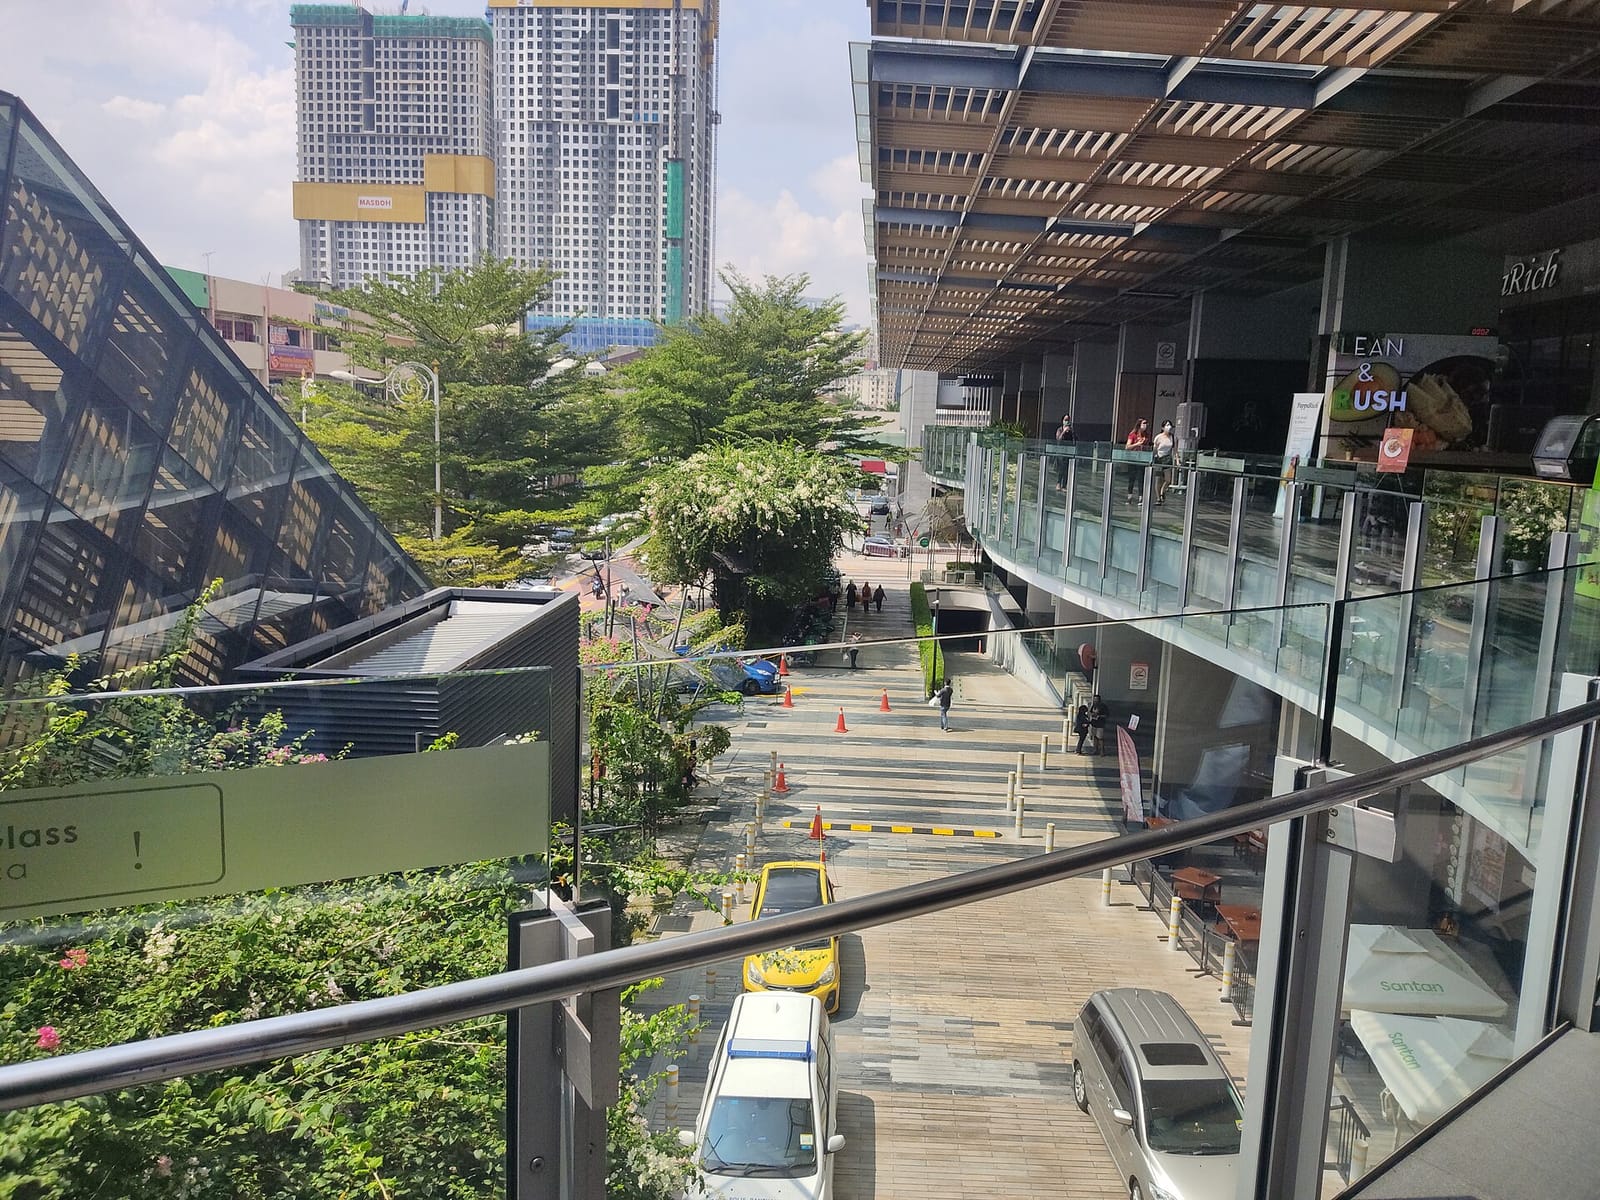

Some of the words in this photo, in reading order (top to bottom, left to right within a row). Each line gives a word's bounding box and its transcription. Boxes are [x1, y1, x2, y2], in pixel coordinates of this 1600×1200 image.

[1340, 336, 1404, 356] LEAN
[1357, 362, 1374, 382] &
[0, 825, 78, 849] lass
